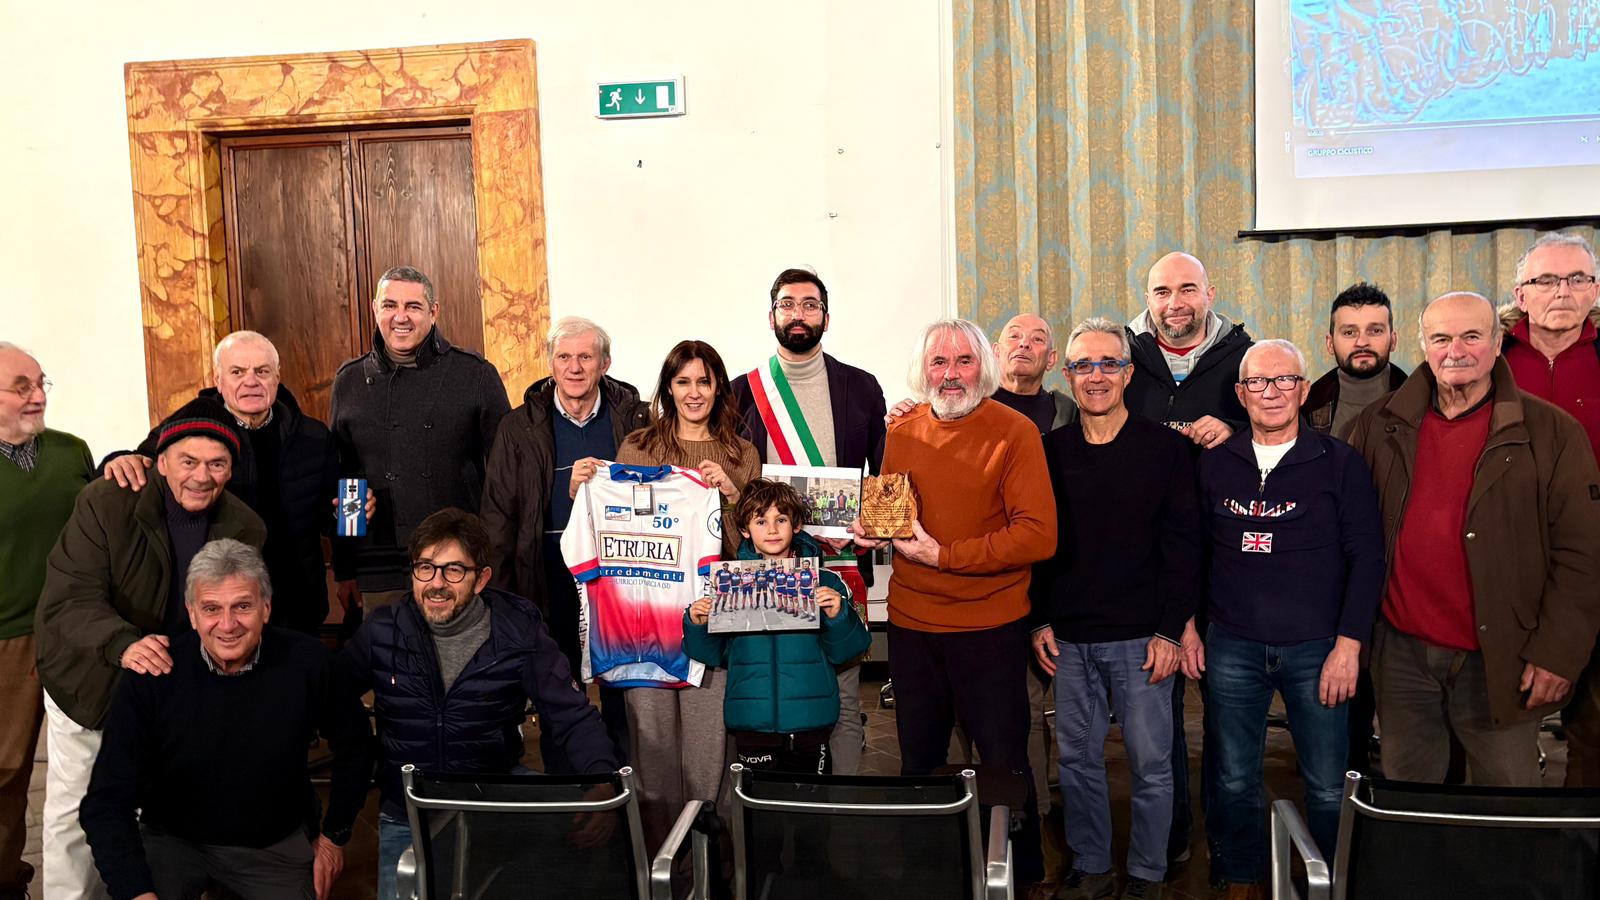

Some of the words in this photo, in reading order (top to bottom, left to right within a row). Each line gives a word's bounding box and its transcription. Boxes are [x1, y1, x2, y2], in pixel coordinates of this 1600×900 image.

[1308, 149, 1336, 157] GRUPPO
[652, 516, 680, 529] 50°
[603, 536, 675, 561] ETRURIA
